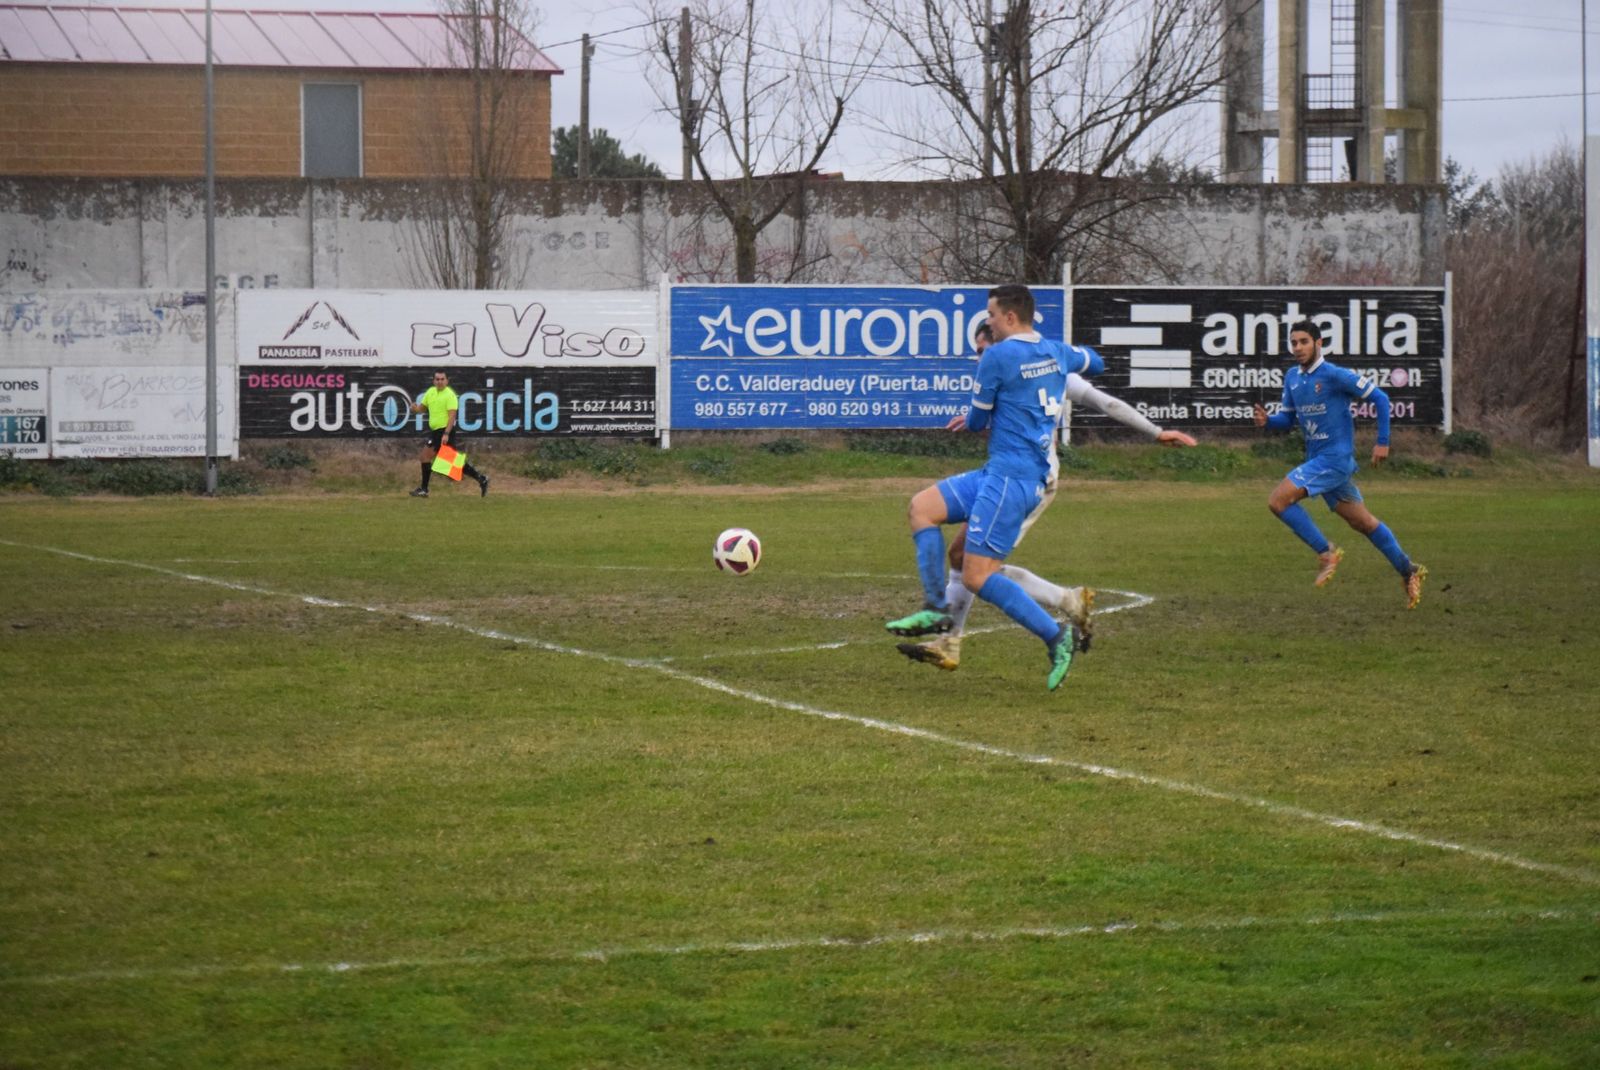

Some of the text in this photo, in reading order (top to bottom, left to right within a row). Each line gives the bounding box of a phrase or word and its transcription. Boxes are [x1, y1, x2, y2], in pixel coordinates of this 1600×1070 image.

[485, 302, 646, 358] Viso
[744, 293, 1043, 356] euronic
[1202, 299, 1419, 356] antalia
[261, 347, 379, 358] PANADERÍA PASTELERÍA
[248, 374, 345, 388] DESGUACES
[1203, 363, 1284, 388] cocinas
[696, 374, 974, 395] C.C. Valderaduey (Puerta McD
[583, 400, 606, 412] 627
[610, 400, 631, 411] 144
[634, 400, 655, 411] 311
[695, 402, 724, 416] 980
[727, 402, 756, 416] 557
[759, 402, 788, 416] 677
[808, 402, 837, 416] 980
[840, 402, 868, 416] 520
[872, 402, 900, 416] 913
[1038, 388, 1061, 416] 4
[1136, 402, 1188, 419] Santa
[15, 417, 40, 429] 167
[15, 430, 40, 443] 170
